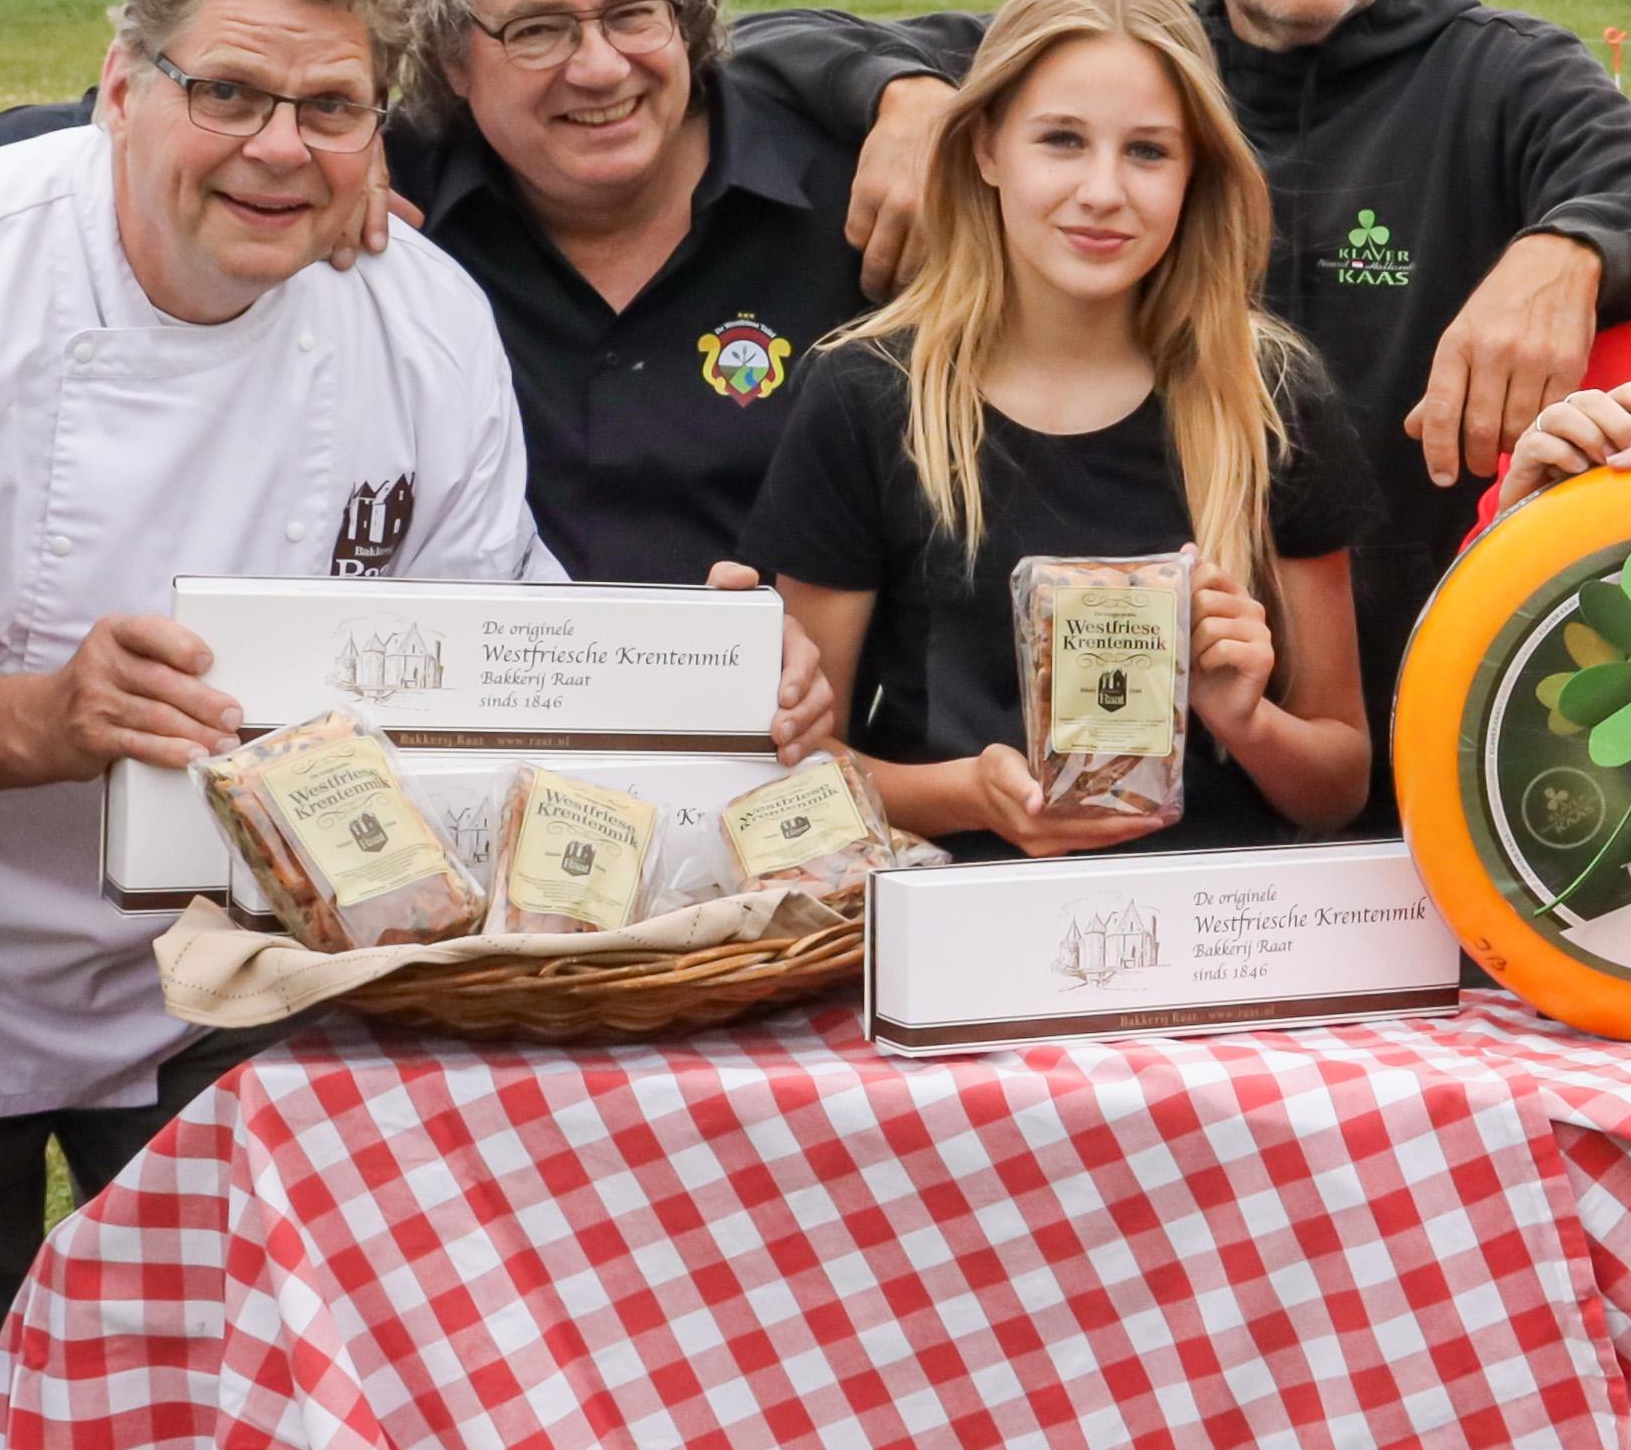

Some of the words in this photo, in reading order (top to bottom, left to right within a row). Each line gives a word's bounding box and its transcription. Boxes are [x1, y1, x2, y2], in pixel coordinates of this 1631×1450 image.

[1338, 248, 1409, 262] KLAVER
[1338, 269, 1409, 286] KAAS
[482, 621, 504, 635] De
[510, 619, 574, 642] originele
[1065, 619, 1161, 636] Westfriese
[1063, 635, 1166, 650] Krentenmik
[483, 641, 608, 672] Westfriesche
[615, 644, 741, 667] Krentenmik
[480, 670, 545, 693] Bakkerij
[551, 672, 592, 686] Raat
[479, 690, 518, 708] sinds
[524, 695, 563, 710] 1846
[400, 733, 452, 747] Bakkerij
[288, 767, 380, 805] Westfriese
[294, 777, 392, 821] Krentenmik
[545, 788, 636, 836] Westfriese
[537, 802, 638, 849] Krentenmik
[1193, 891, 1214, 906] De
[1218, 883, 1278, 910] originele
[1194, 904, 1308, 942] Westfriesche
[1314, 896, 1427, 927] Krentenmik
[1193, 940, 1252, 962] Bakkerij
[1258, 939, 1293, 954] Raat
[1193, 960, 1228, 982] sinds
[1233, 964, 1268, 980] 1846
[1120, 1015, 1169, 1028] Bakkerij
